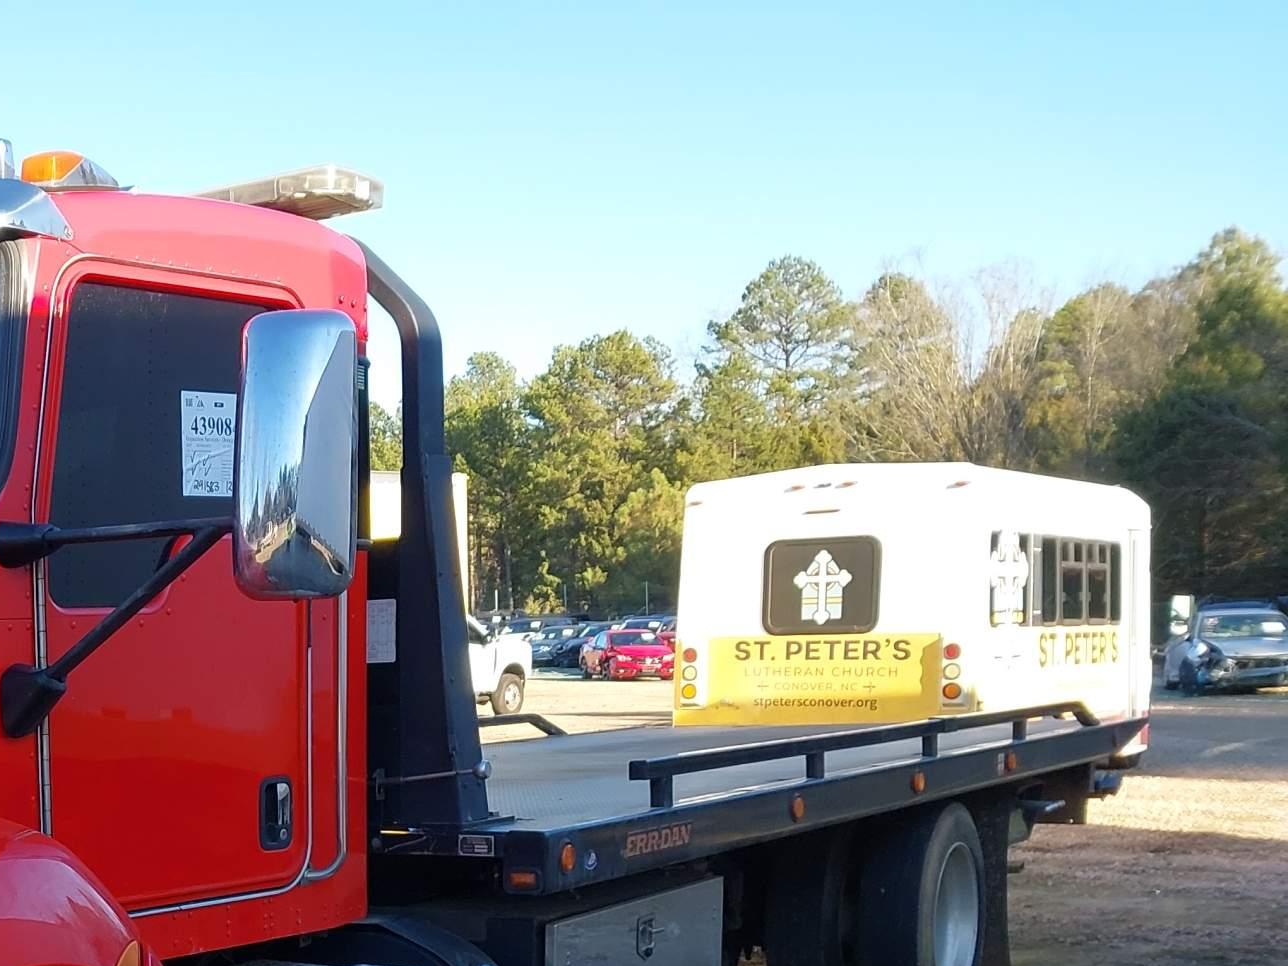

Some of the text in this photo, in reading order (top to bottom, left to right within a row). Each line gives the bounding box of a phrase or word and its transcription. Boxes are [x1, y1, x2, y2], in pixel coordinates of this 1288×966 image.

[191, 415, 234, 436] 43908
[734, 638, 912, 661] ST. PETER'S
[1039, 632, 1061, 667] ST.
[744, 666, 899, 678] LUTHERAN CHURCH
[774, 682, 858, 692] CONOVER, NC
[753, 697, 878, 711] stpetersconover.org
